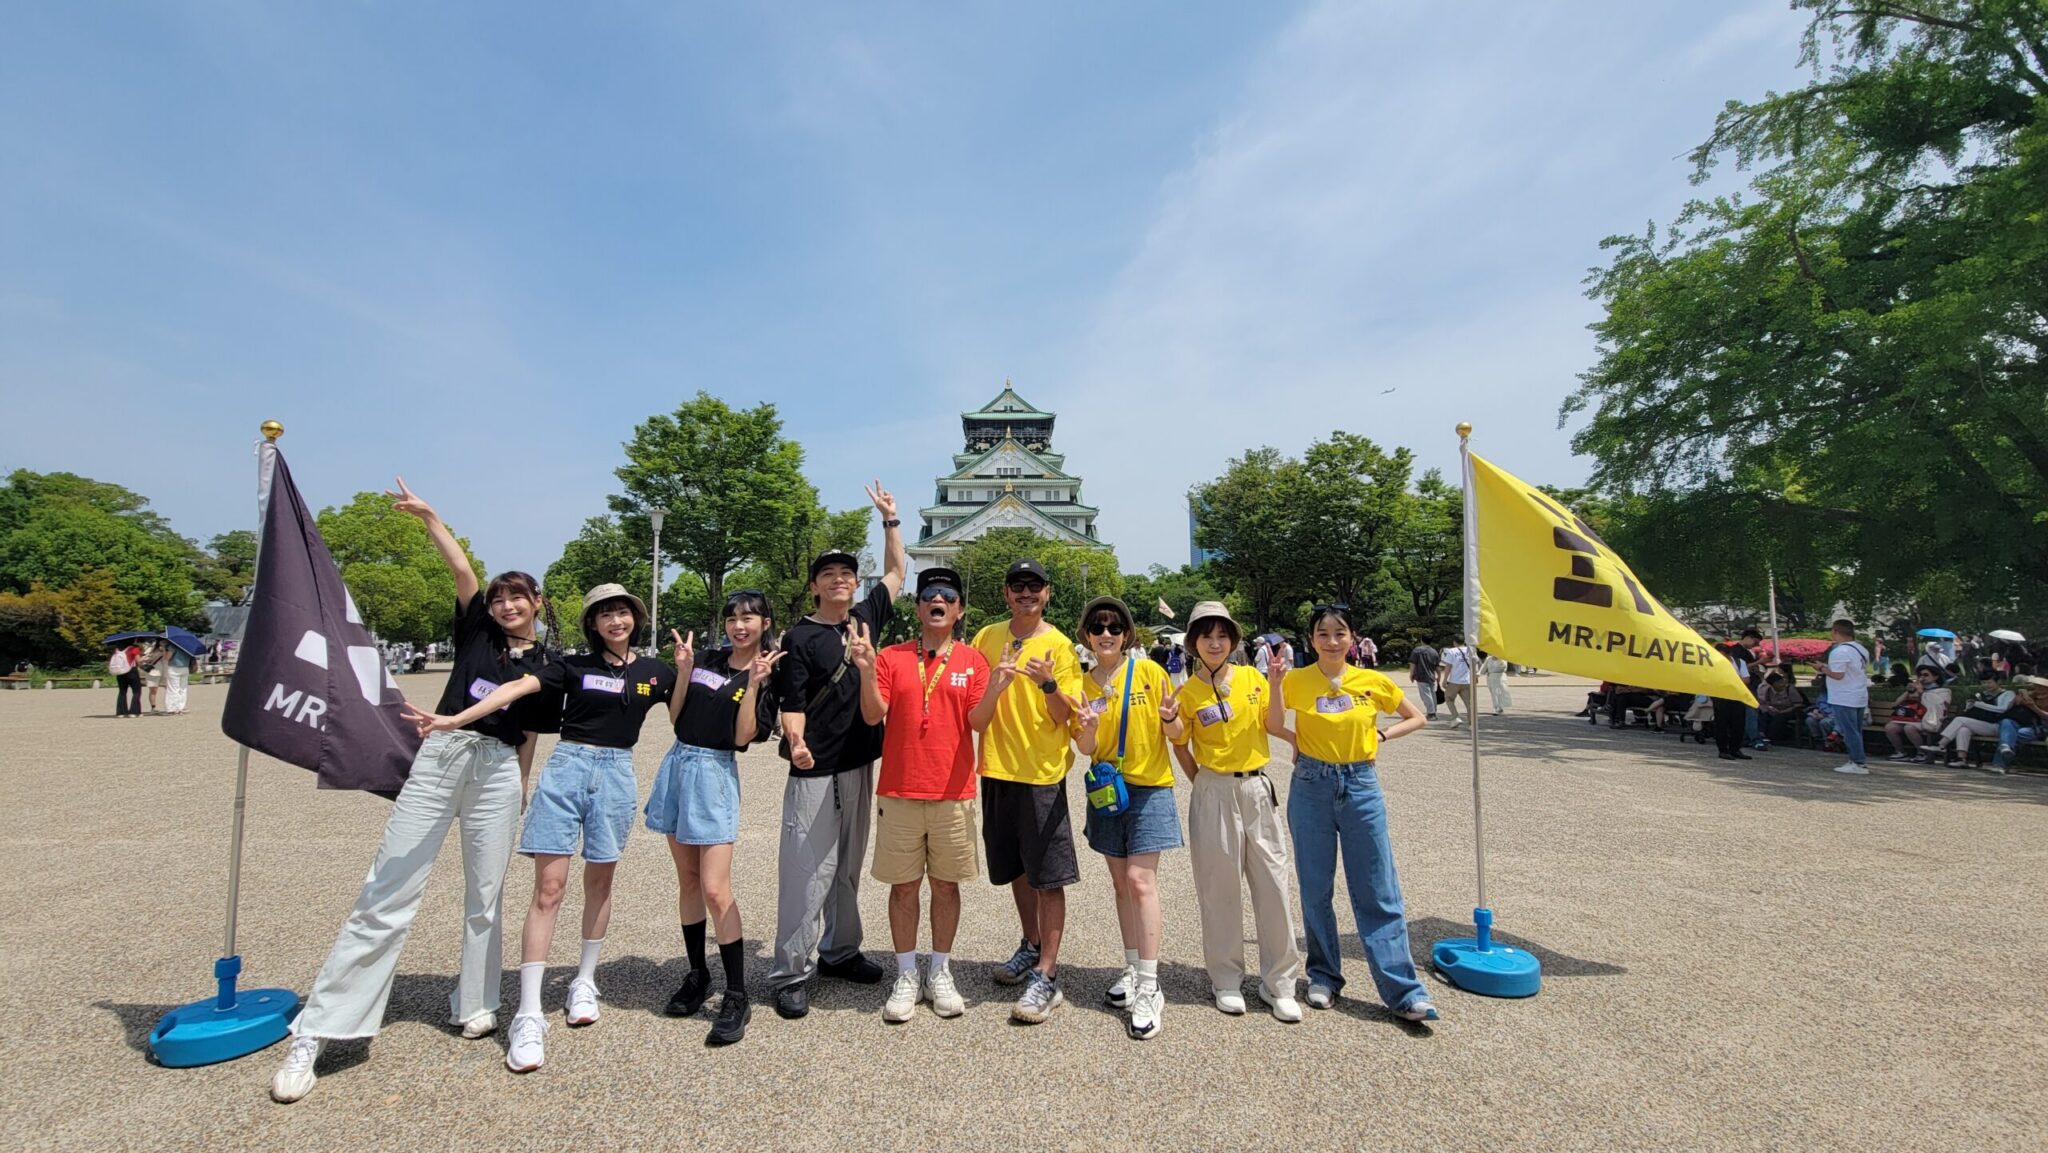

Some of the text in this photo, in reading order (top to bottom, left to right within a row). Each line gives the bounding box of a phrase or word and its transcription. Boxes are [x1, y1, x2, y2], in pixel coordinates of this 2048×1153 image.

[1548, 620, 1714, 667] MR.PLAYER
[950, 672, 968, 688] 玩
[636, 682, 651, 697] 玩
